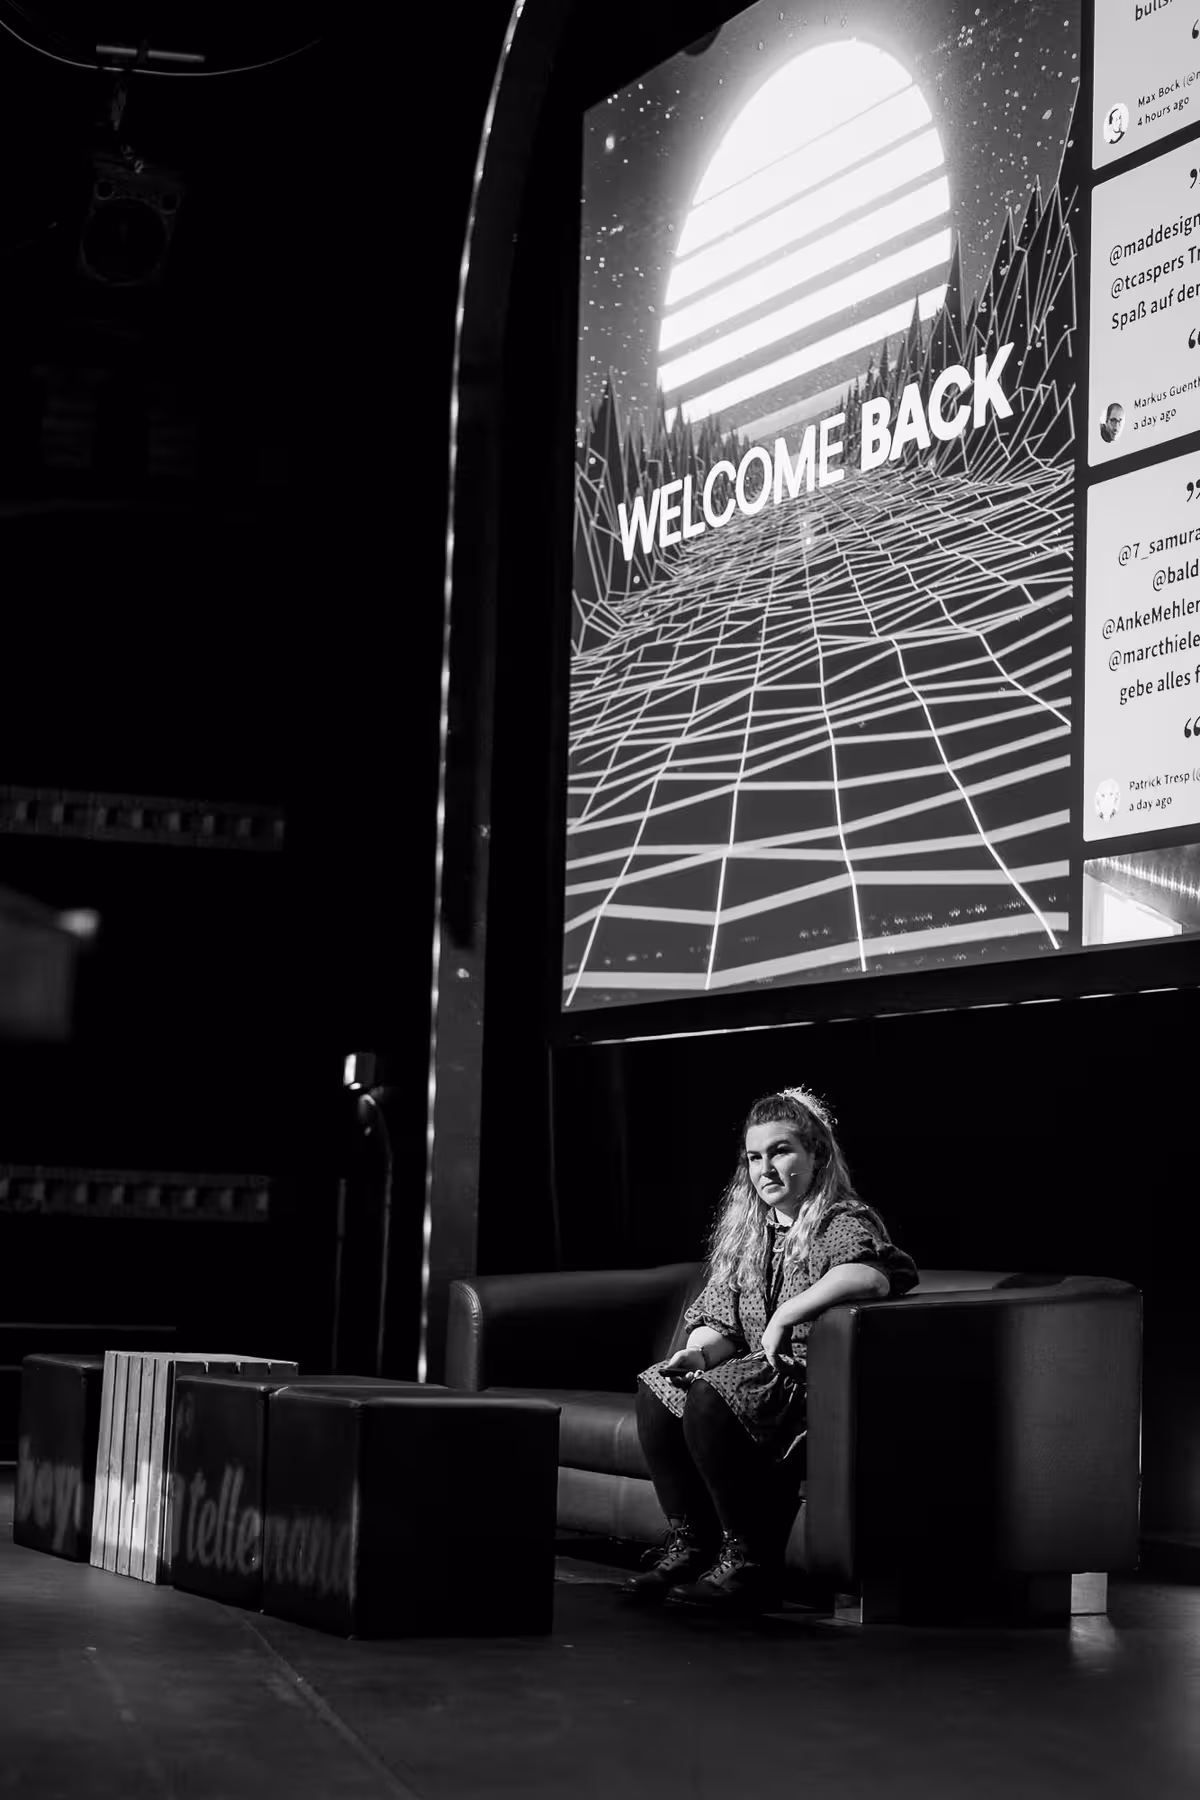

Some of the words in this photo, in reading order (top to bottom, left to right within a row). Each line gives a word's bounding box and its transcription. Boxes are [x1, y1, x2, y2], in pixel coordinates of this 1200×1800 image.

[1138, 92, 1155, 108] Max
[1158, 79, 1180, 98] Bock
[1137, 117, 1143, 126] 4
[1145, 104, 1171, 124] hours
[1173, 96, 1190, 110] ago
[1111, 255, 1184, 299] @tcaspers
[1111, 300, 1147, 331] Spaß
[1150, 288, 1175, 314] auf
[1134, 391, 1167, 409] Markus
[1133, 421, 1139, 430] a
[1141, 415, 1157, 428] day
[1160, 408, 1177, 422] ago
[617, 411, 846, 561] WELCOME
[861, 341, 1015, 472] BACK
[1118, 527, 1200, 567] @7_samura
[1152, 558, 1199, 592] @bald
[1108, 631, 1200, 672] @marcthiele
[1119, 679, 1153, 705] gebe
[1157, 670, 1191, 692] alles
[1129, 775, 1162, 791] Patrick
[1164, 772, 1190, 785] Tresp
[1129, 803, 1134, 812] a
[1136, 798, 1153, 813] day
[1155, 796, 1172, 810] ago
